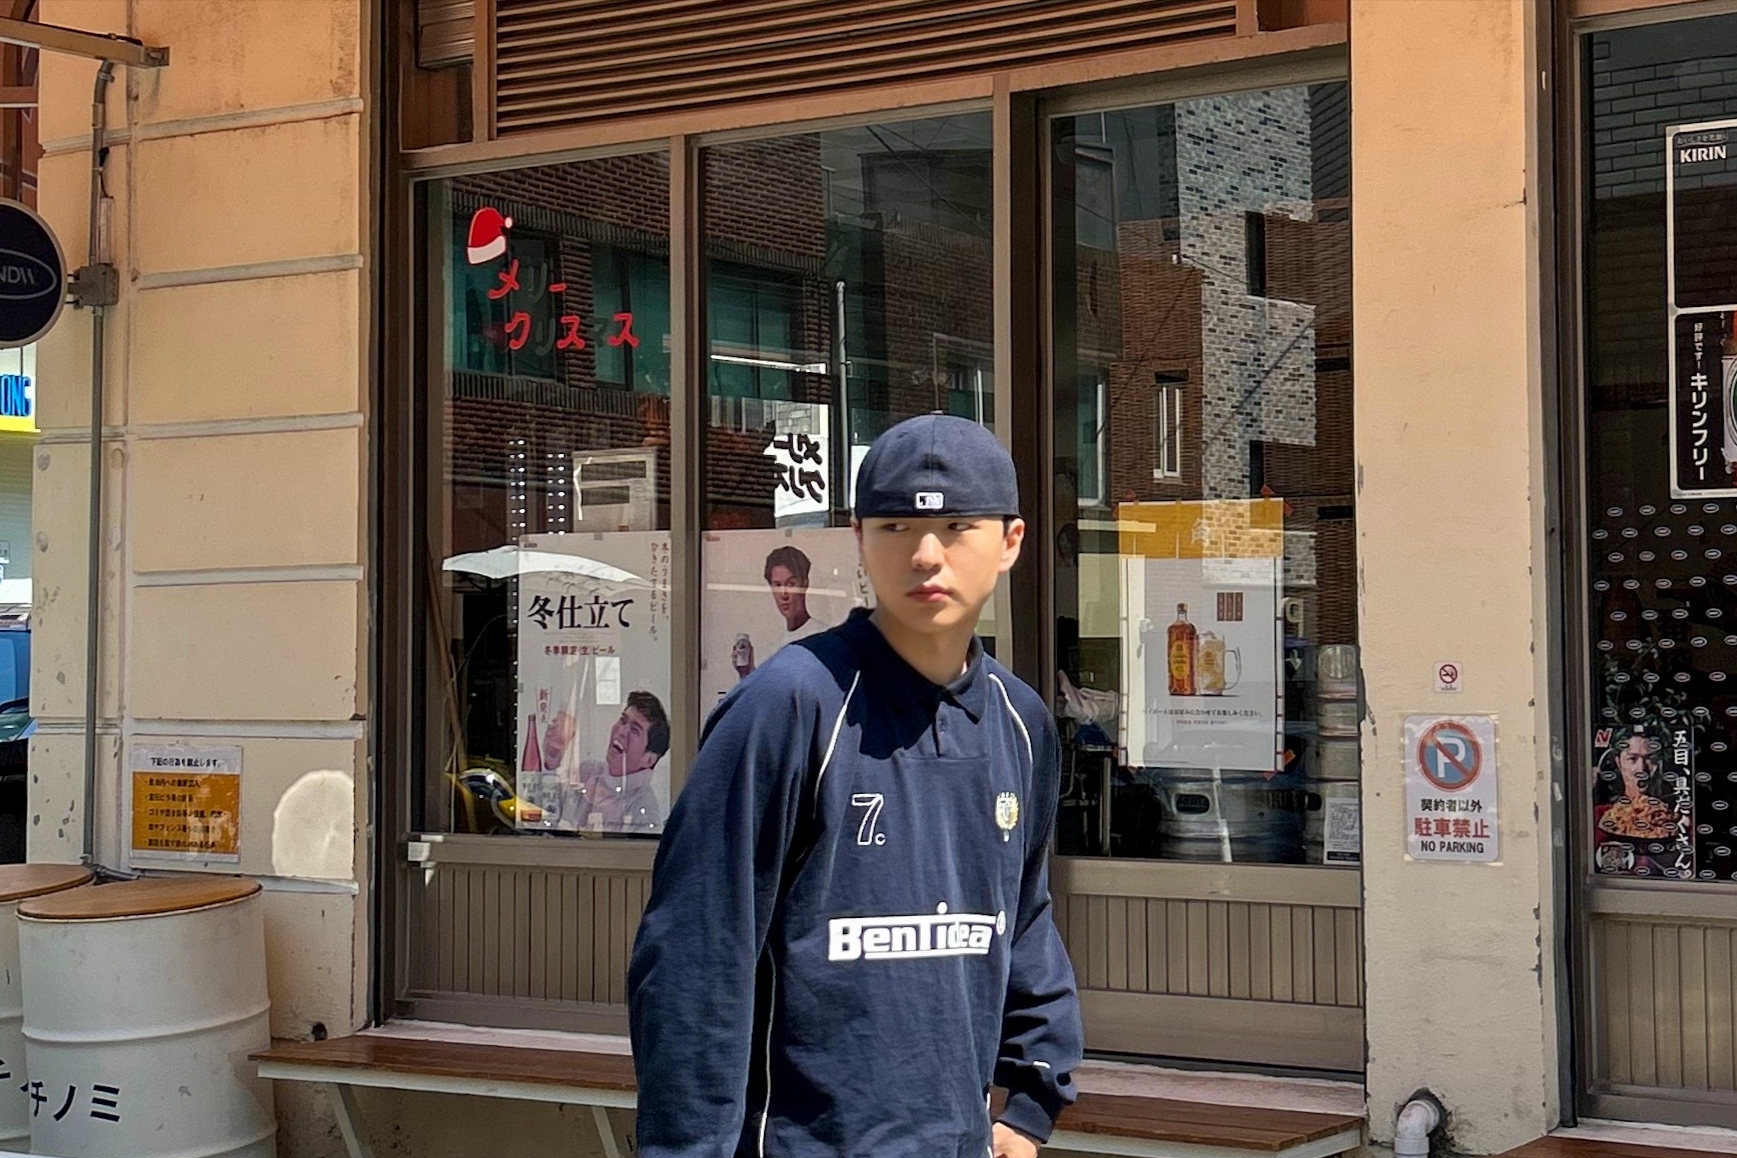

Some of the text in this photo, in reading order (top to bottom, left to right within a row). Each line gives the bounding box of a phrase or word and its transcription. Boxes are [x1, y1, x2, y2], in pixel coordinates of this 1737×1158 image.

[1680, 145, 1727, 164] KIRIN
[1690, 372, 1708, 480] キリンフリー
[527, 595, 635, 630] 冬仕立て
[1420, 798, 1483, 813] 契約者以外
[1414, 817, 1490, 839] 駐車禁止
[1420, 840, 1484, 853] NO PARKING
